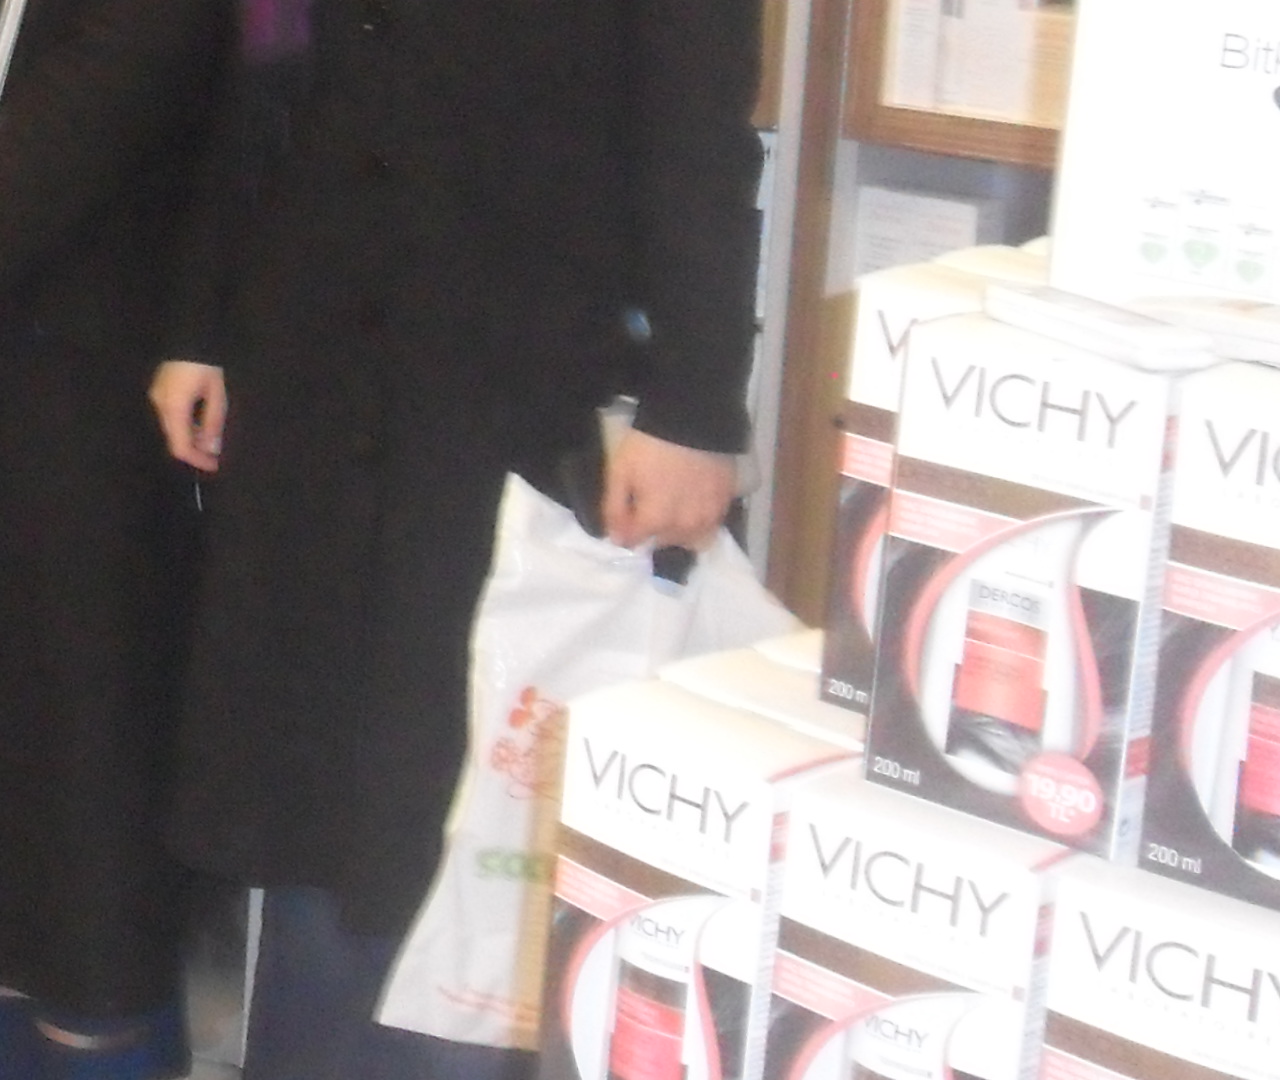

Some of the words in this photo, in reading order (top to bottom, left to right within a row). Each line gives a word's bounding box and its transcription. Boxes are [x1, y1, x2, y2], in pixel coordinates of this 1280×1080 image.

[930, 356, 1138, 449] VICHY
[1205, 418, 1280, 487] VI
[827, 678, 853, 702] 200
[871, 754, 900, 780] 200
[901, 763, 920, 787] ml
[583, 736, 750, 844] VICHY
[1147, 842, 1180, 867] 200
[1181, 854, 1202, 875] ml
[809, 822, 1011, 938] VICHY
[628, 914, 685, 945] VICHY
[864, 1015, 930, 1049] VICHY
